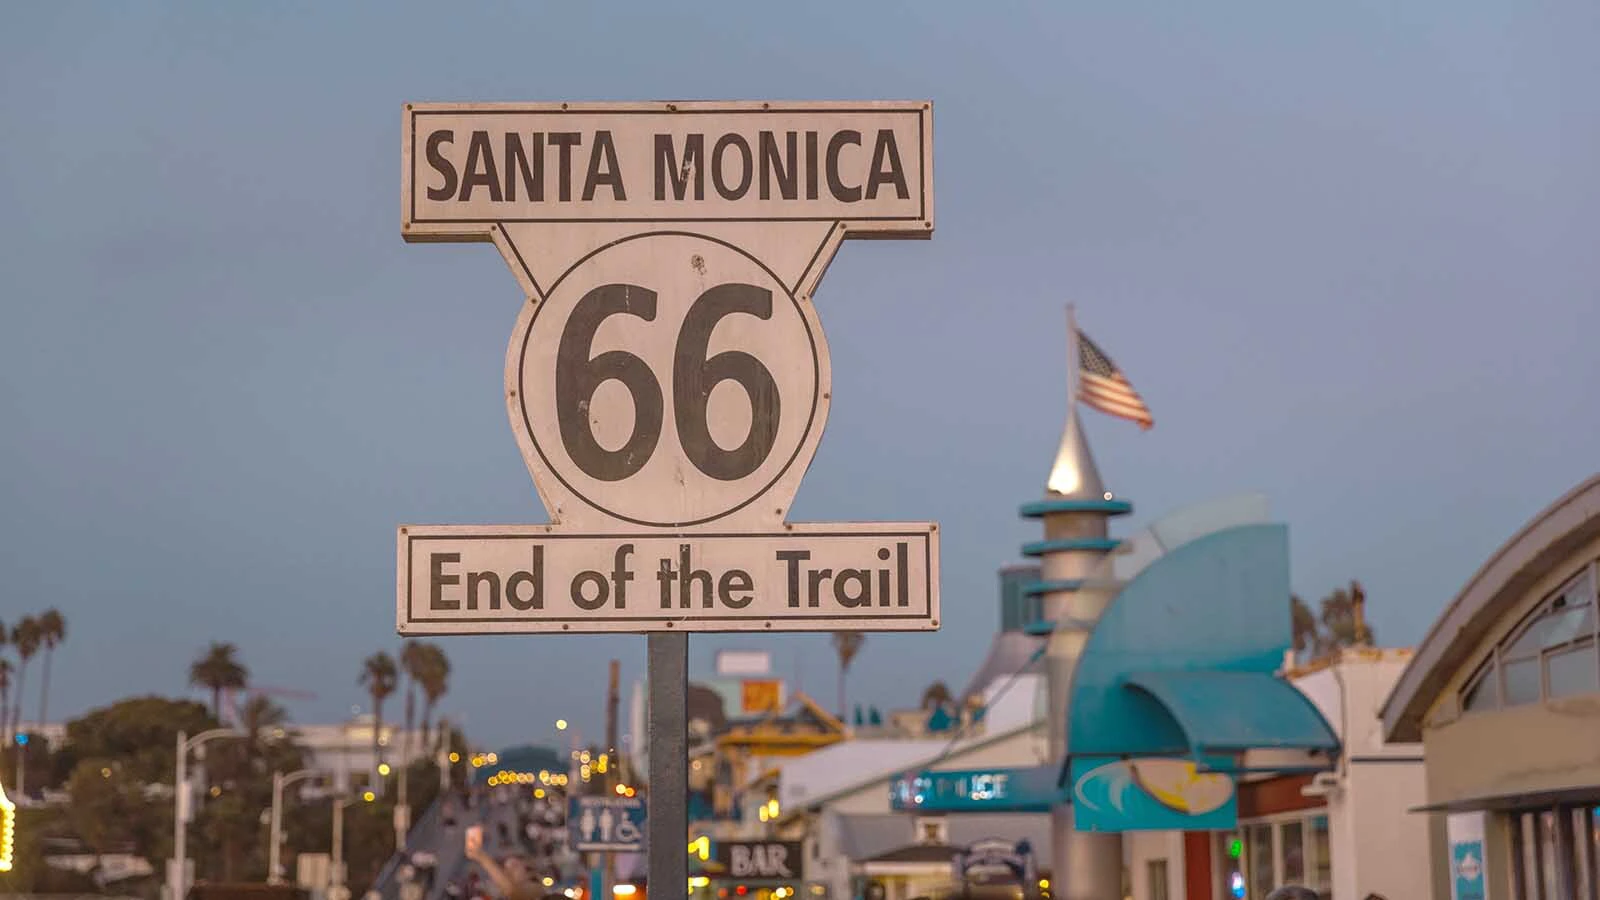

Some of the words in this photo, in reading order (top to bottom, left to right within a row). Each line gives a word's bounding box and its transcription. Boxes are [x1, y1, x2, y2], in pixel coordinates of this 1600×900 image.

[426, 129, 627, 203] SANTA
[654, 129, 910, 203] MONICA
[556, 283, 780, 482] 66
[430, 544, 544, 611] End
[571, 543, 634, 610] of
[657, 543, 753, 610] the
[776, 542, 908, 609] Trail
[731, 844, 792, 878] BAR
